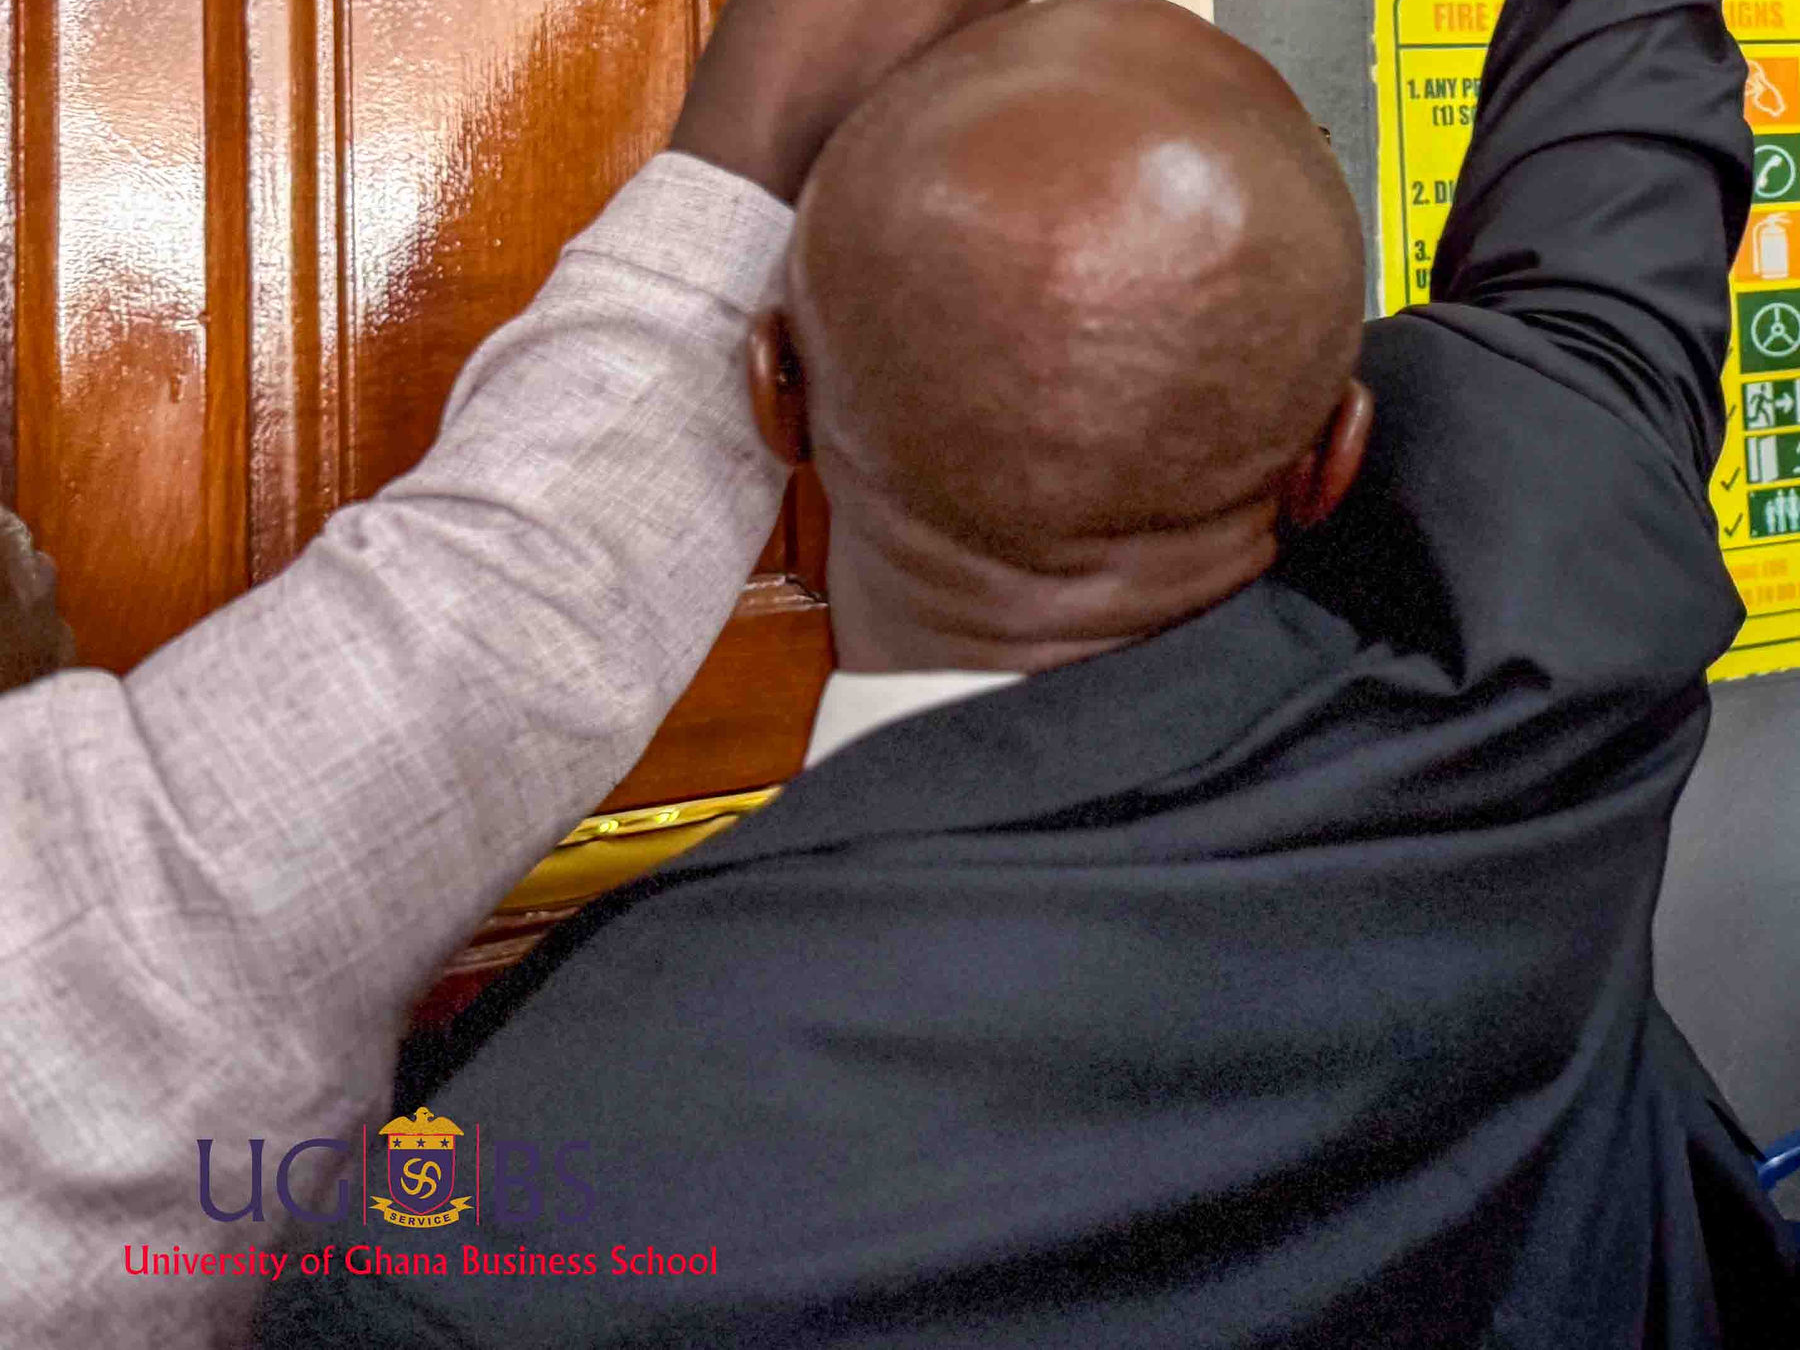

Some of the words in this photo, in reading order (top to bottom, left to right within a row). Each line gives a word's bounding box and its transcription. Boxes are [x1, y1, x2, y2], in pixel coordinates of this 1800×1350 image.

[1433, 3, 1489, 32] FIRE
[1724, 0, 1785, 27] IGNS
[1408, 78, 1420, 100] 1.
[1425, 78, 1457, 100] ANY
[1412, 180, 1430, 205] 2.
[1414, 240, 1431, 263] 3.
